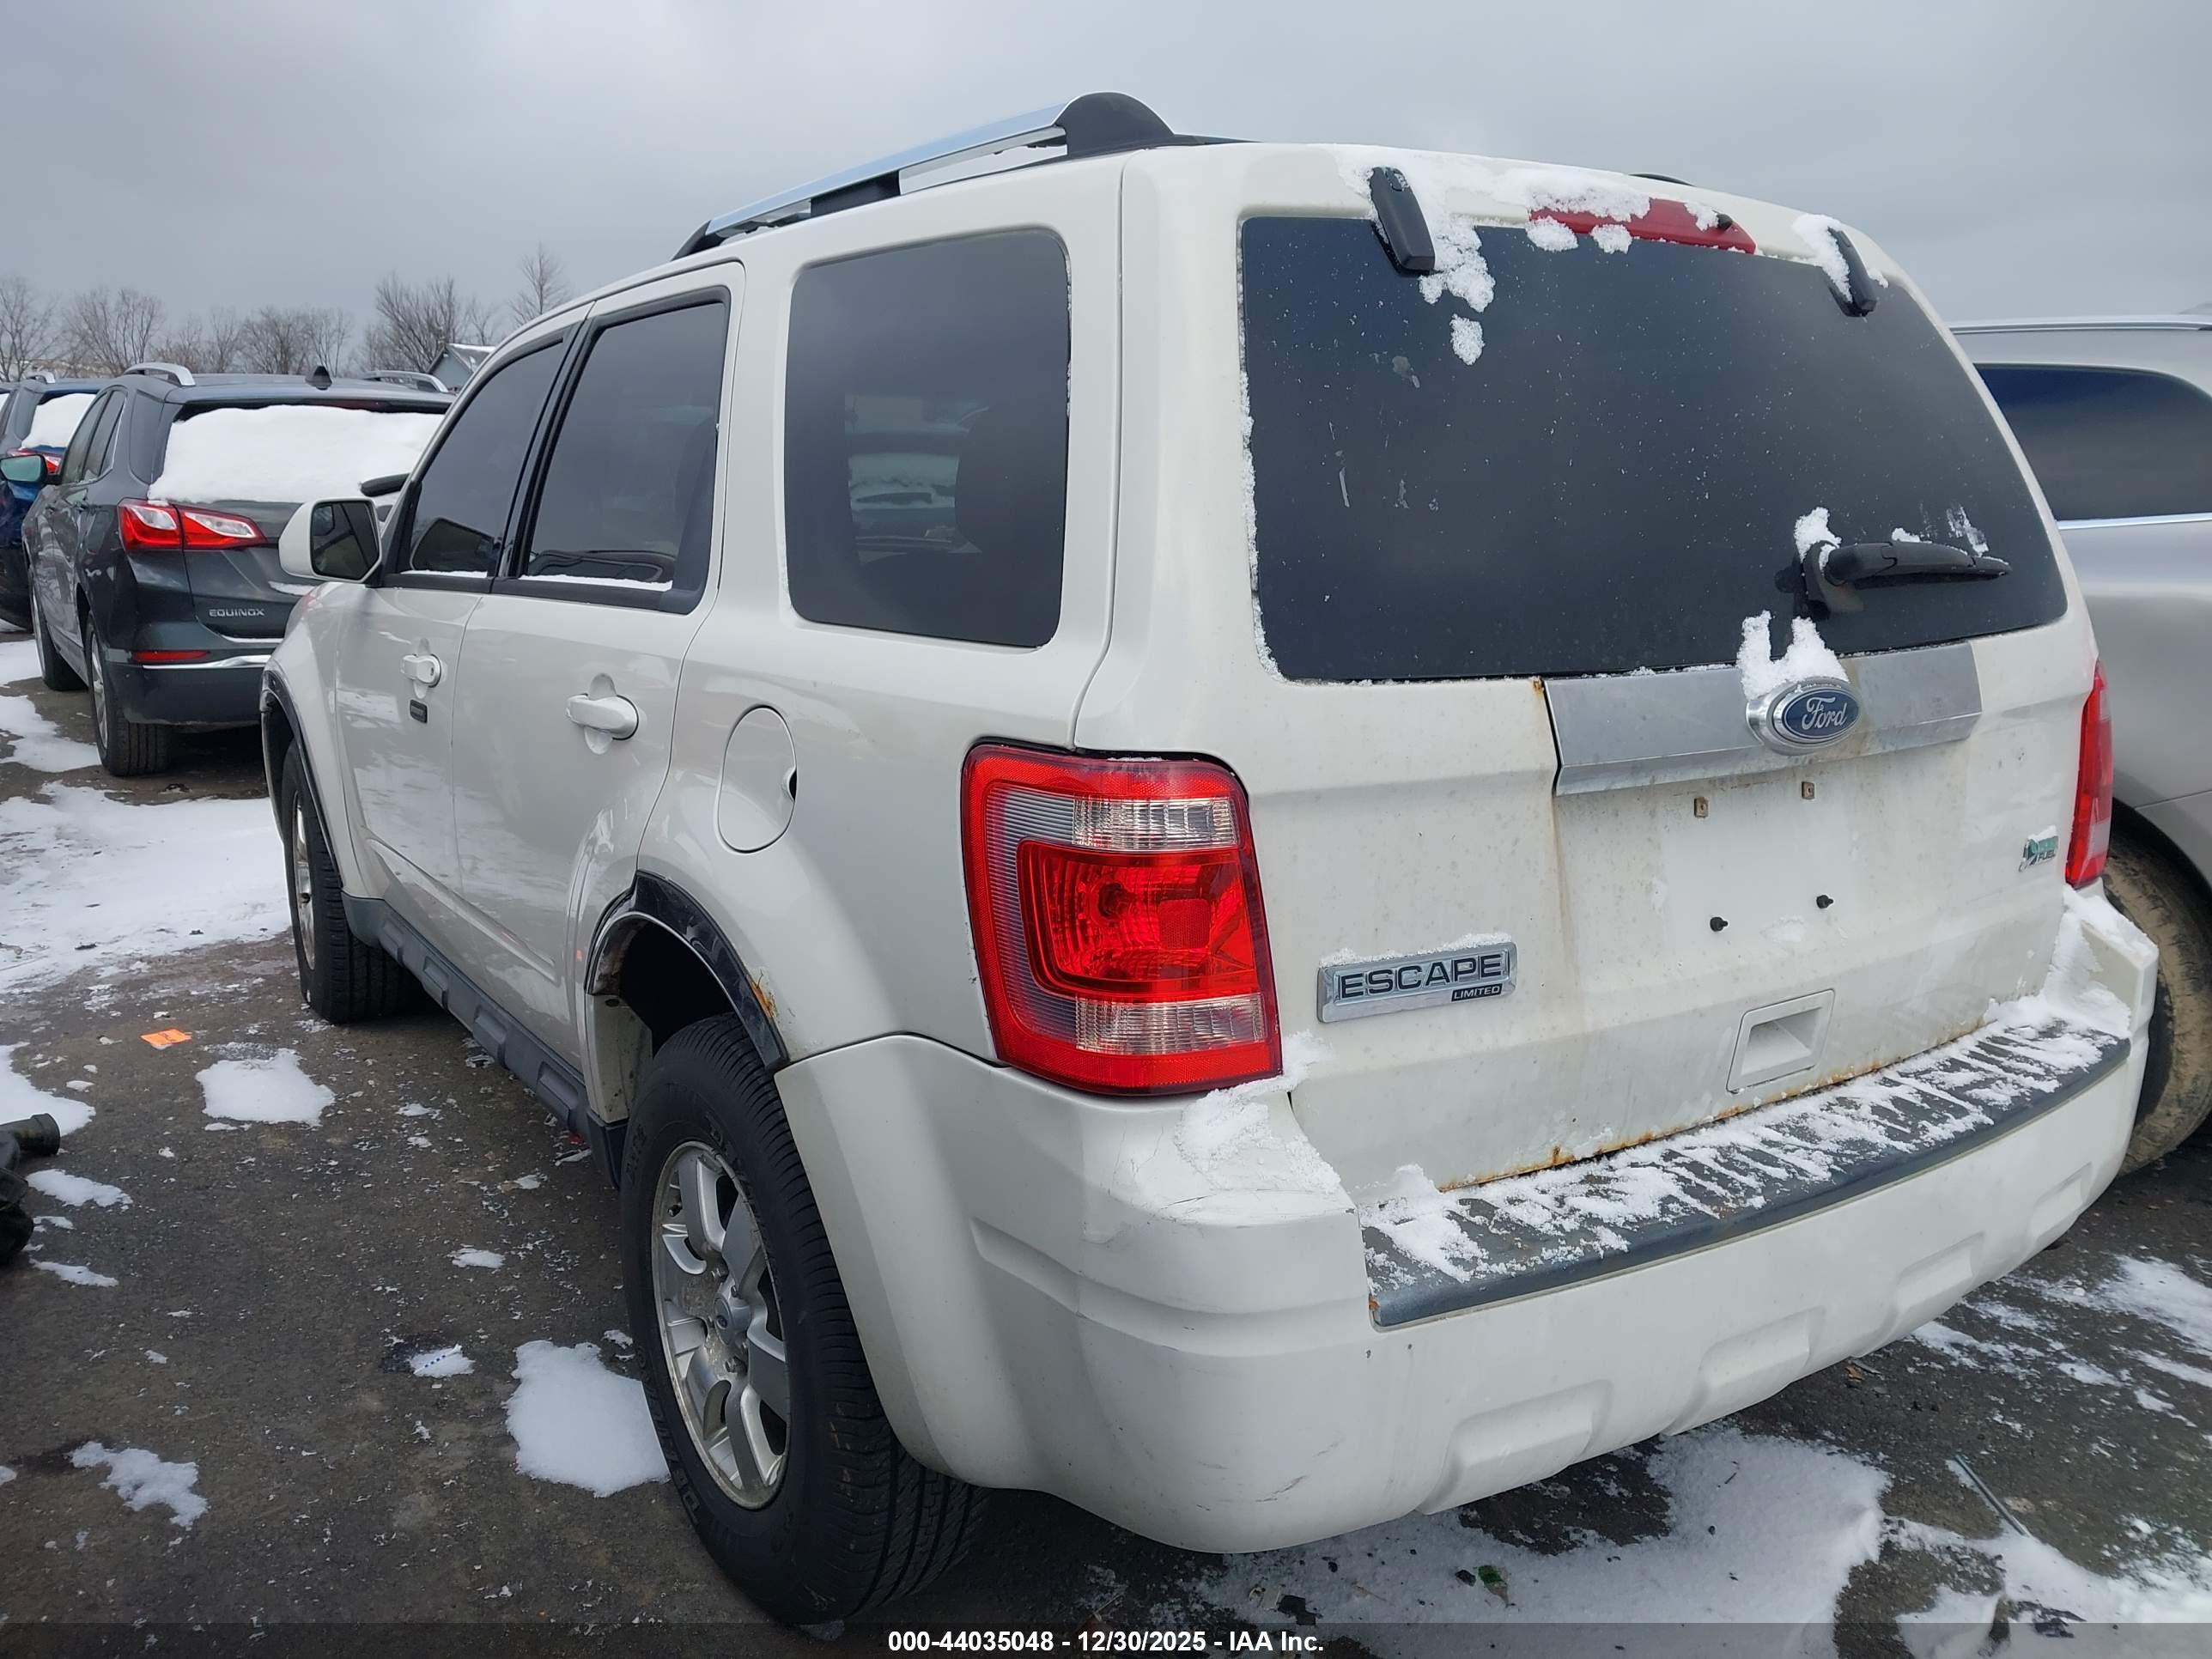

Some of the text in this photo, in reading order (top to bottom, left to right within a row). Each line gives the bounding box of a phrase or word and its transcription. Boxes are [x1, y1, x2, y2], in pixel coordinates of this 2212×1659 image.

[209, 608, 265, 617] EQUINOX
[1802, 696, 1848, 730] Ford
[1340, 954, 1502, 999] ESCAPE
[1453, 985, 1499, 1000] LIMITED
